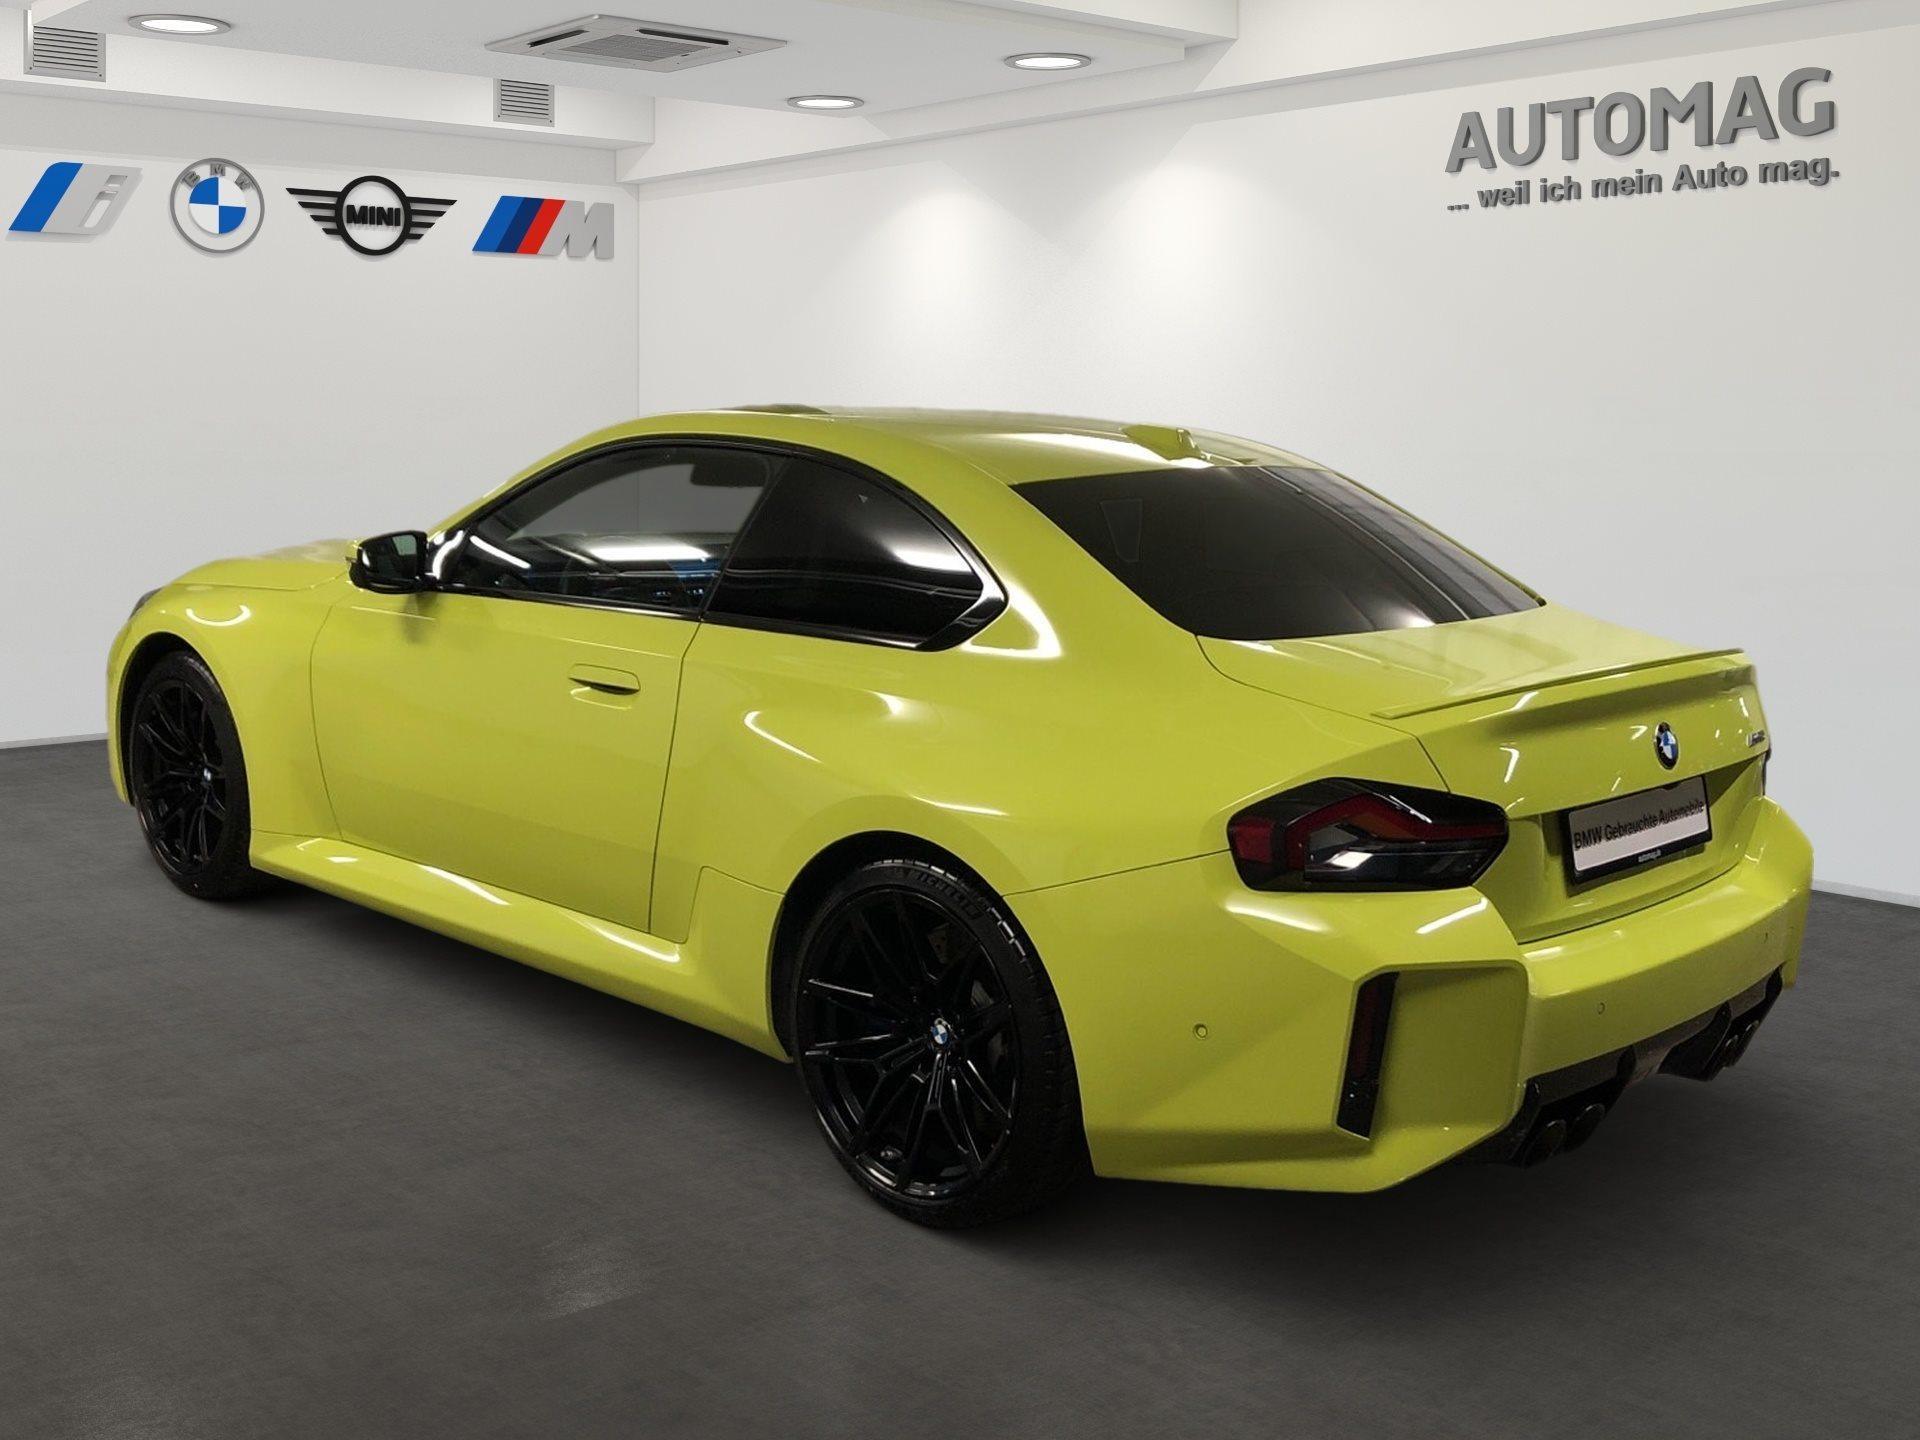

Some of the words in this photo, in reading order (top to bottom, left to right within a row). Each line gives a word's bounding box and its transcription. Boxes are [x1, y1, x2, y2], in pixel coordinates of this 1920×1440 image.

[1445, 67, 1835, 173] AUTOMAG
[182, 163, 252, 189] BMW
[1477, 180, 1531, 208] weil
[1540, 175, 1581, 203] ich
[1591, 169, 1662, 198] mein
[1672, 161, 1747, 191] Auto
[1758, 157, 1840, 186] mag.
[346, 204, 401, 227] MINI
[1574, 825, 1602, 849] BMW
[1605, 814, 1658, 841] Gebrauchte
[1659, 799, 1704, 825] Automobile
